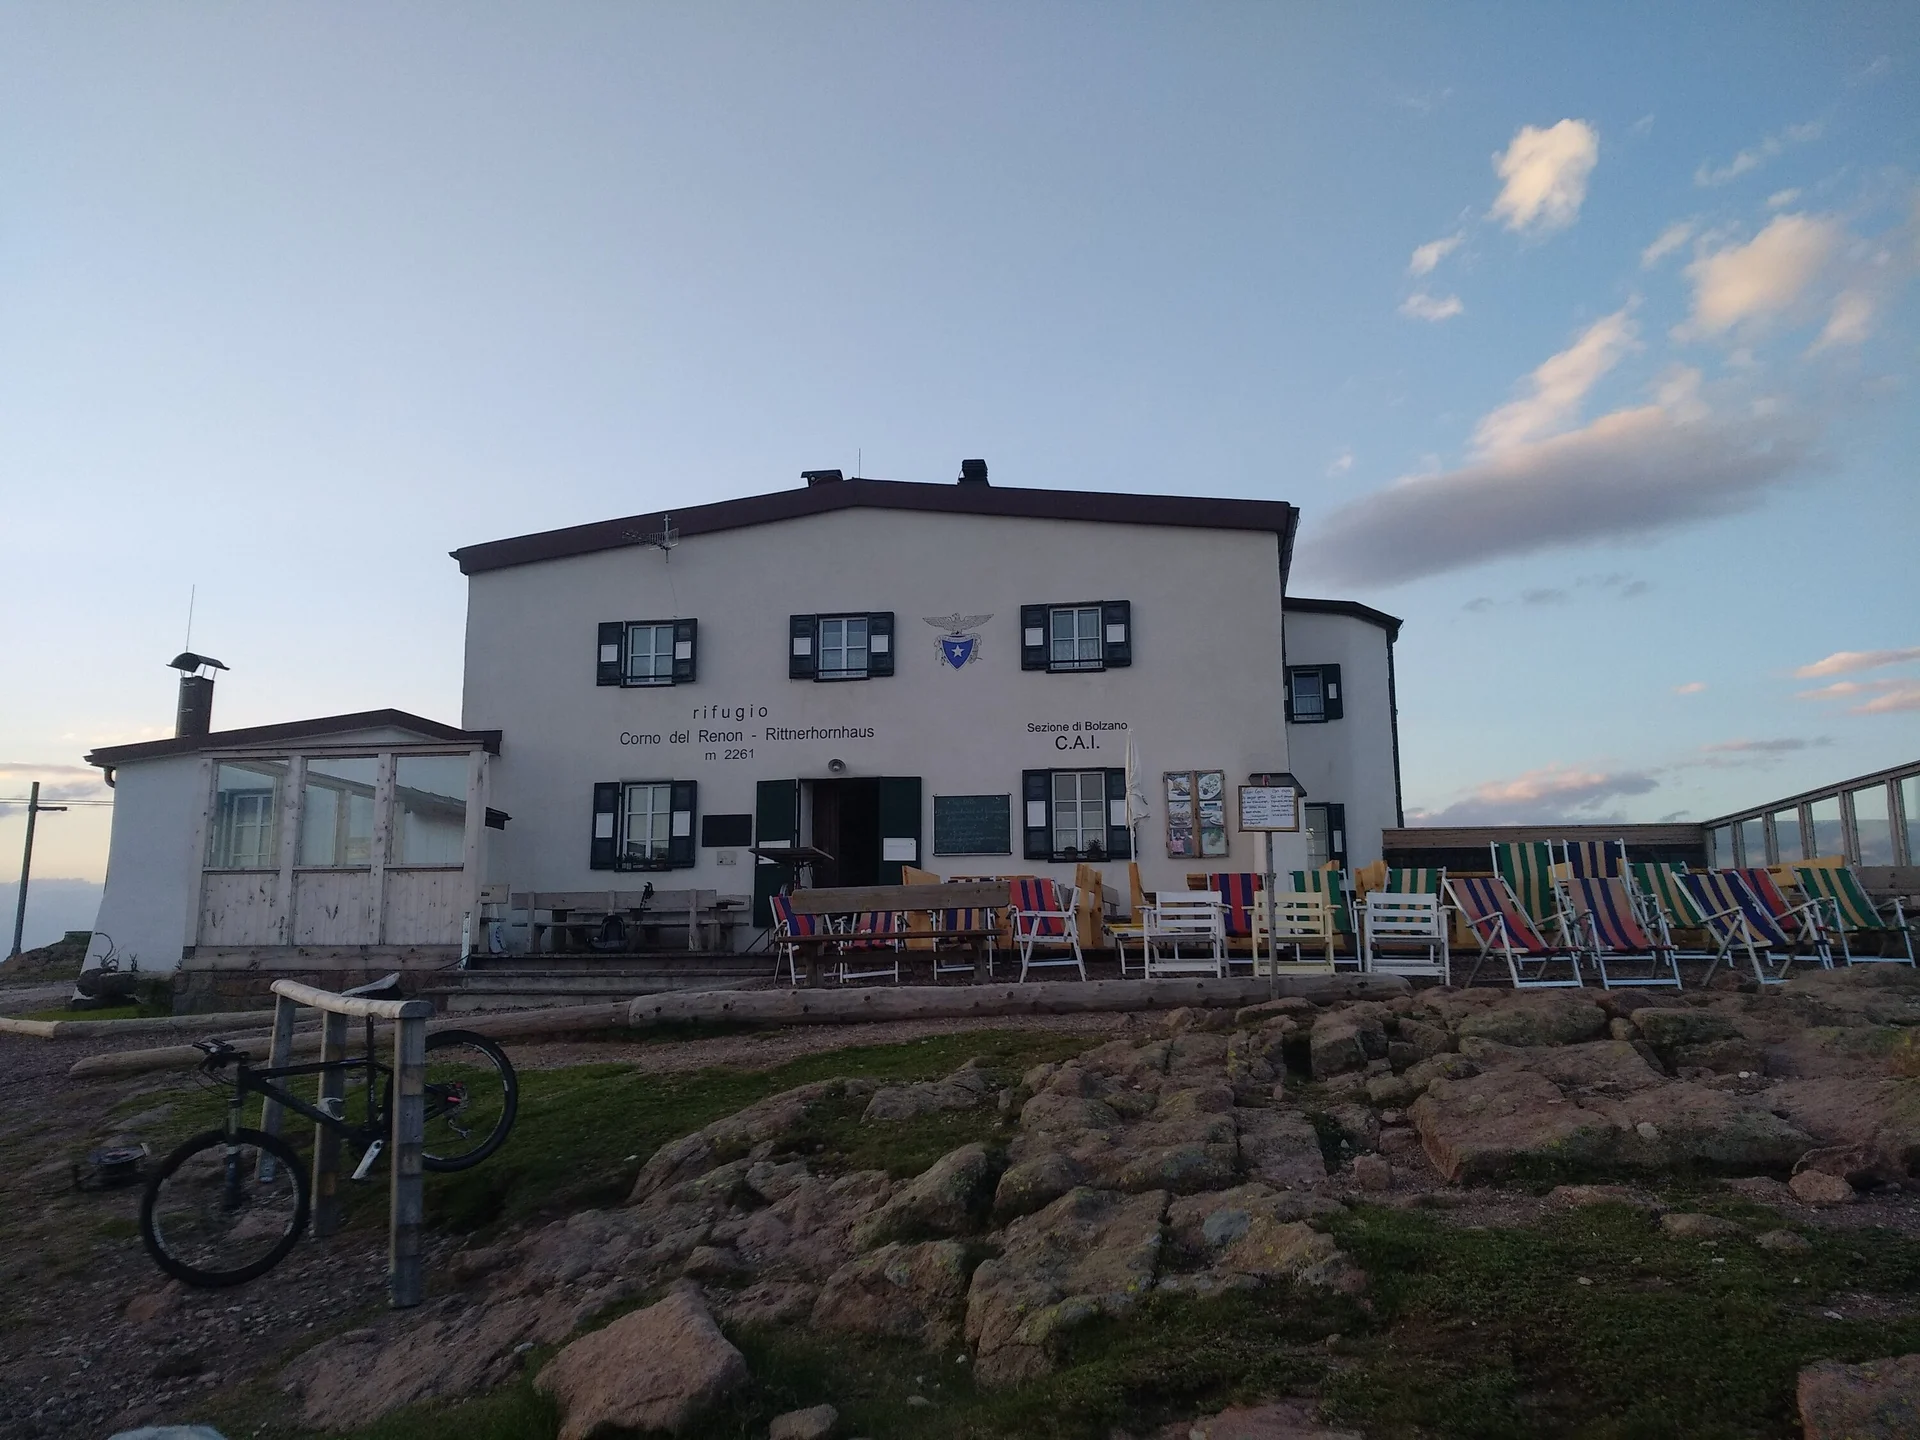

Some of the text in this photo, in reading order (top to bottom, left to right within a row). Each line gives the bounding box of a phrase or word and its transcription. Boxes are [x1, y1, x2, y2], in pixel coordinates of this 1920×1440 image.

[692, 704, 768, 721] rifugio
[1027, 720, 1128, 733] Sezione di Bolzano
[619, 732, 661, 745] Corno
[669, 730, 690, 744] del
[698, 729, 743, 743] Renon
[765, 726, 875, 740] Rittnerhornhaus
[1055, 735, 1100, 751] C.A.I.
[704, 749, 754, 761] m 2261
